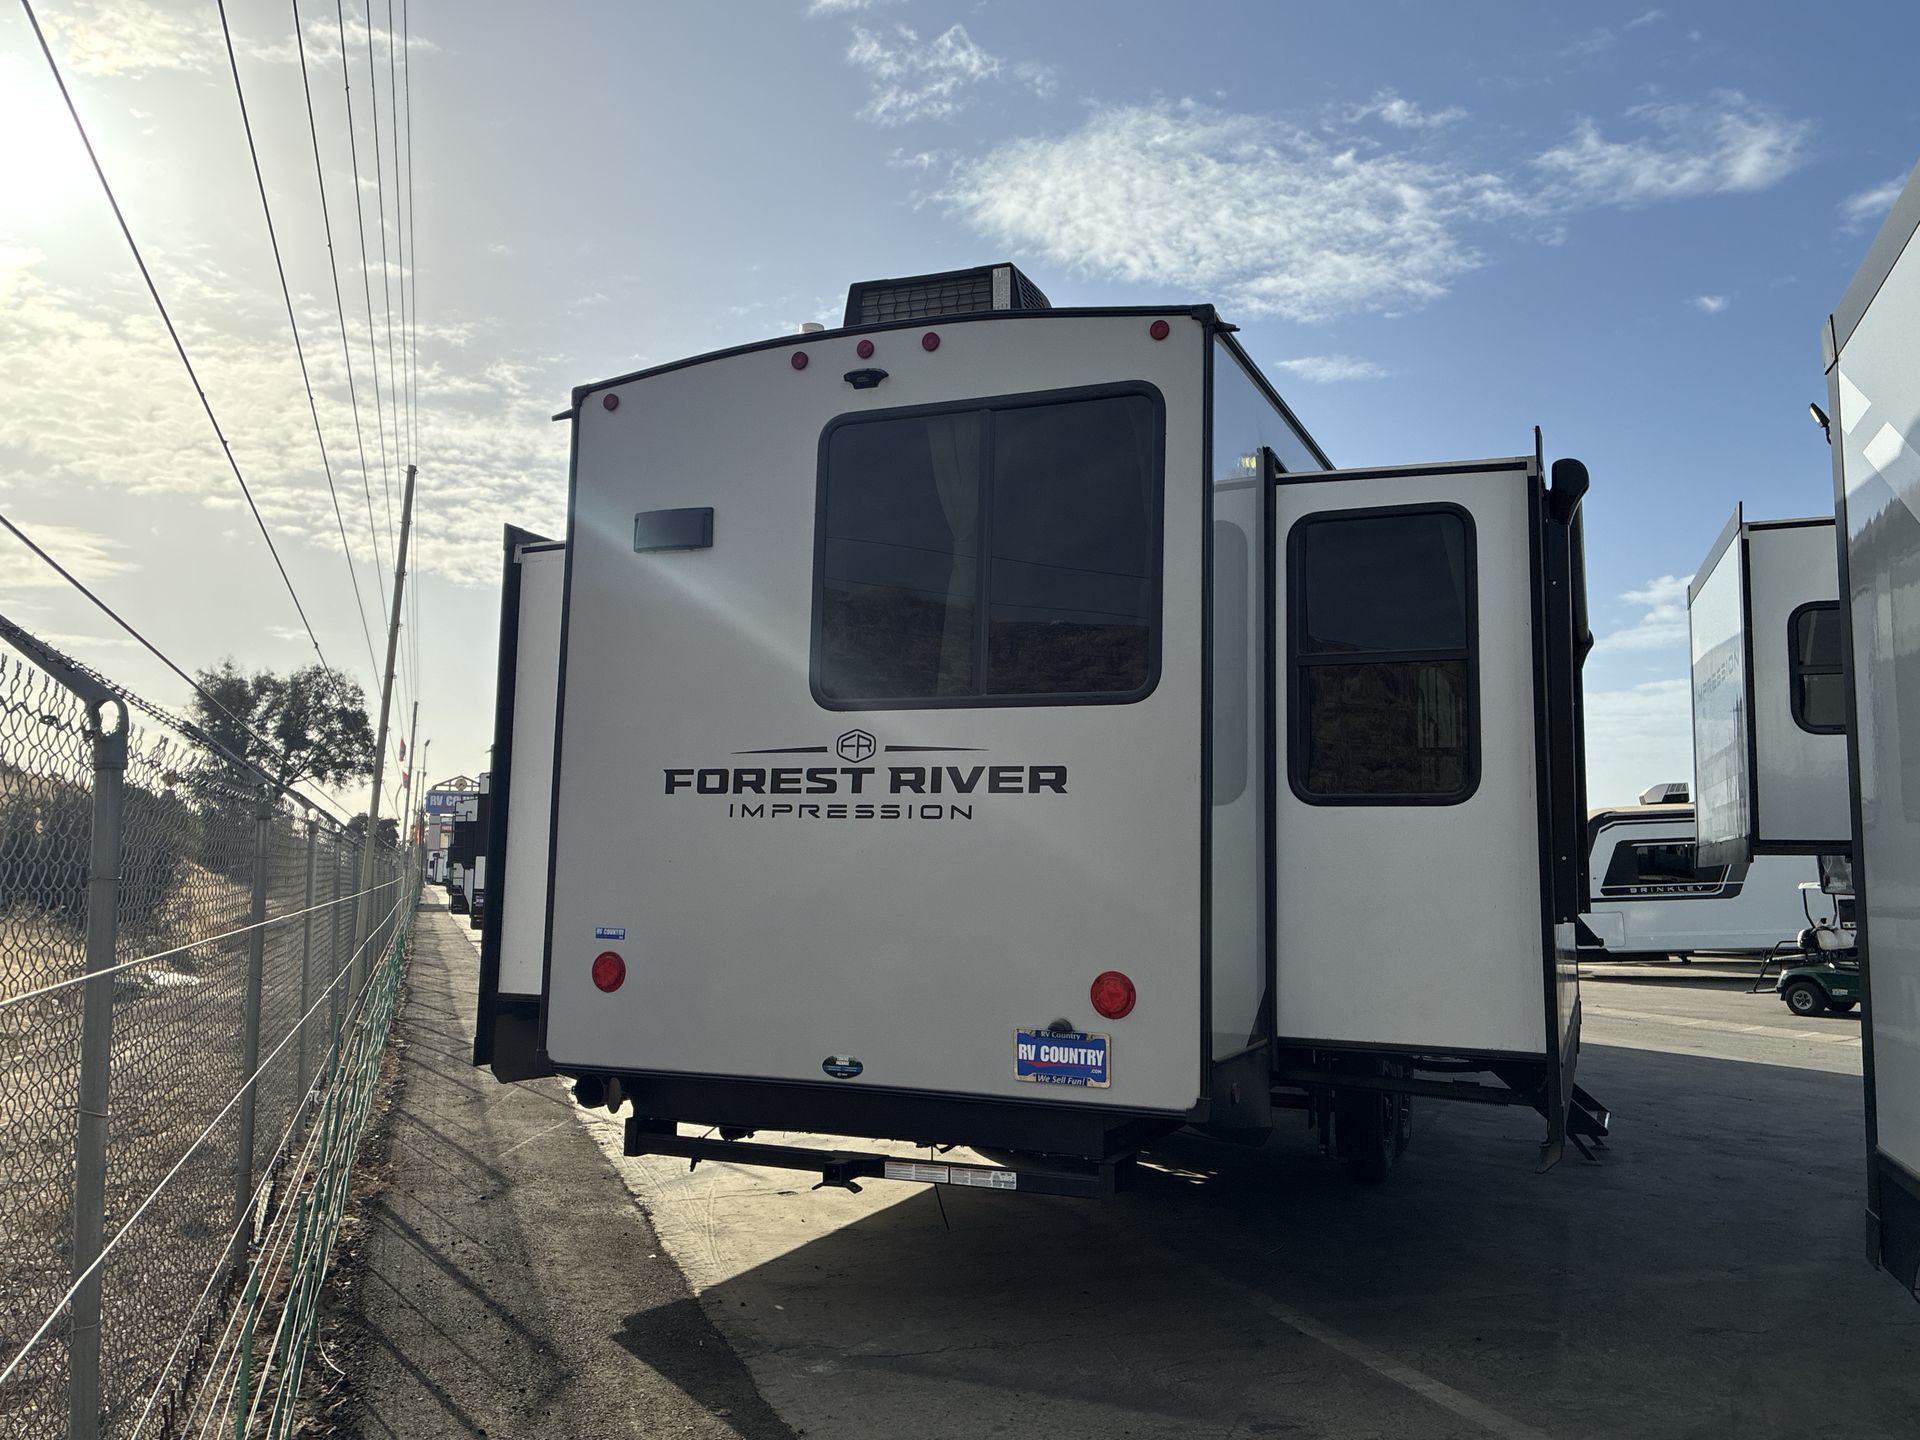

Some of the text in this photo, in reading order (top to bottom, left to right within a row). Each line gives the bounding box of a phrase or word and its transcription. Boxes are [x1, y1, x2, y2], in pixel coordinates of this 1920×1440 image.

[663, 765, 1068, 795] FOREST RIVER
[430, 795, 442, 806] RV
[729, 803, 973, 820] IMPRESSION
[1630, 885, 1703, 893] BRINKLEY
[1051, 1031, 1081, 1041] Country
[1018, 1044, 1104, 1067] RV COUNTRY
[1038, 1075, 1085, 1086] We Sell Fun!
